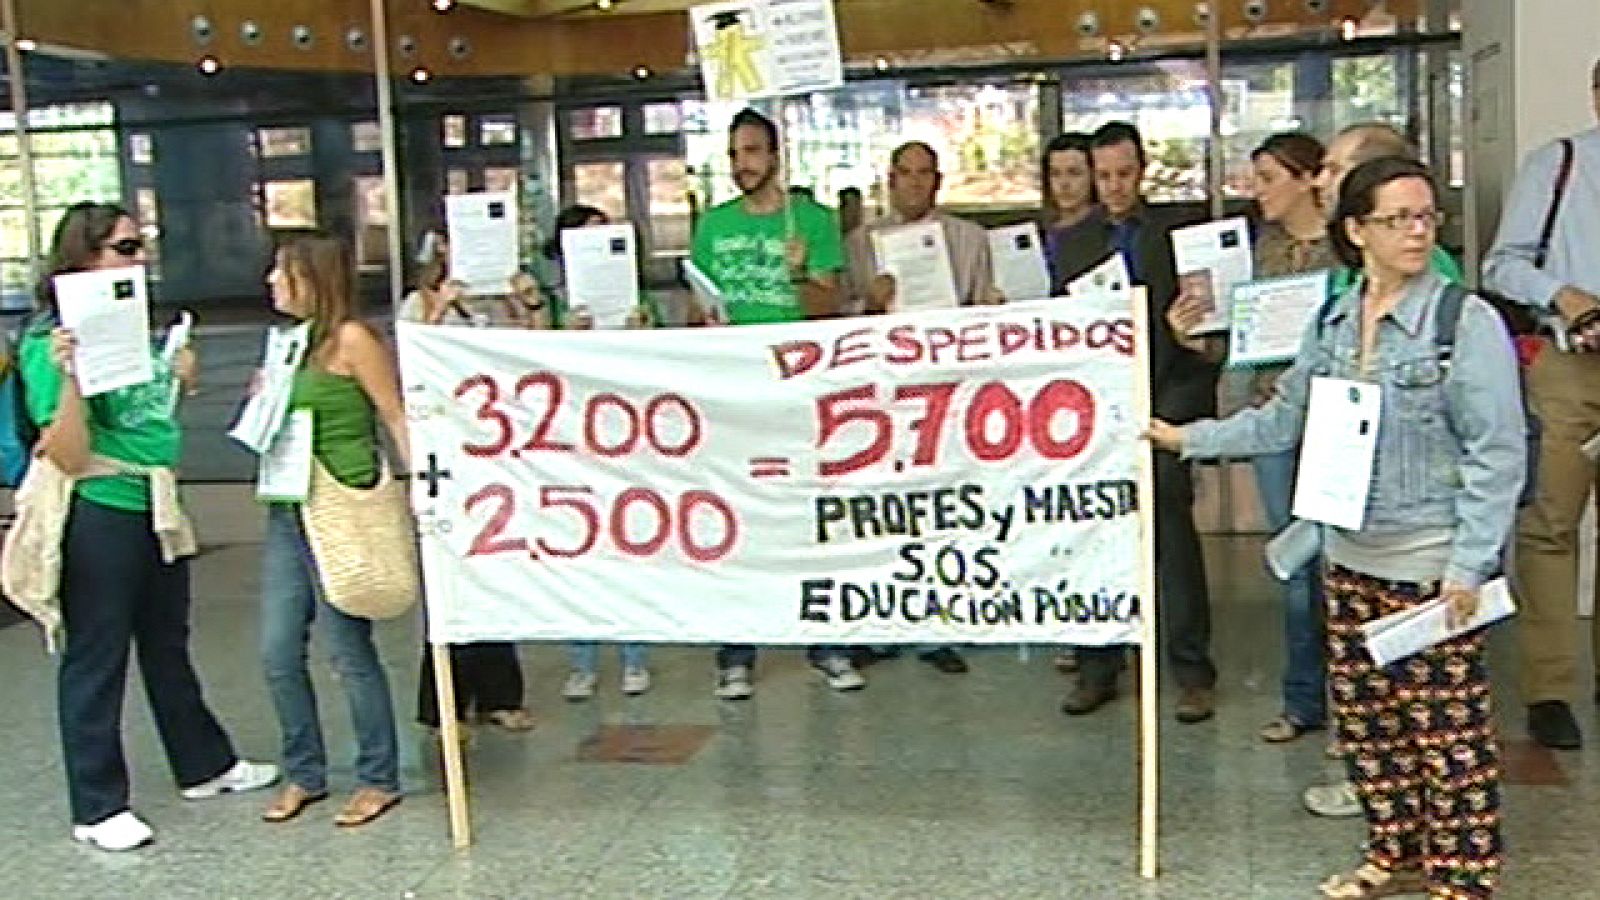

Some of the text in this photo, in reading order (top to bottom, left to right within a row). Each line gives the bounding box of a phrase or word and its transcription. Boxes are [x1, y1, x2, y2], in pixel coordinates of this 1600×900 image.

[455, 371, 702, 458] 3.200
[814, 379, 1096, 477] 5.700
[464, 483, 738, 562] 2.500
[815, 484, 986, 543] PROFES
